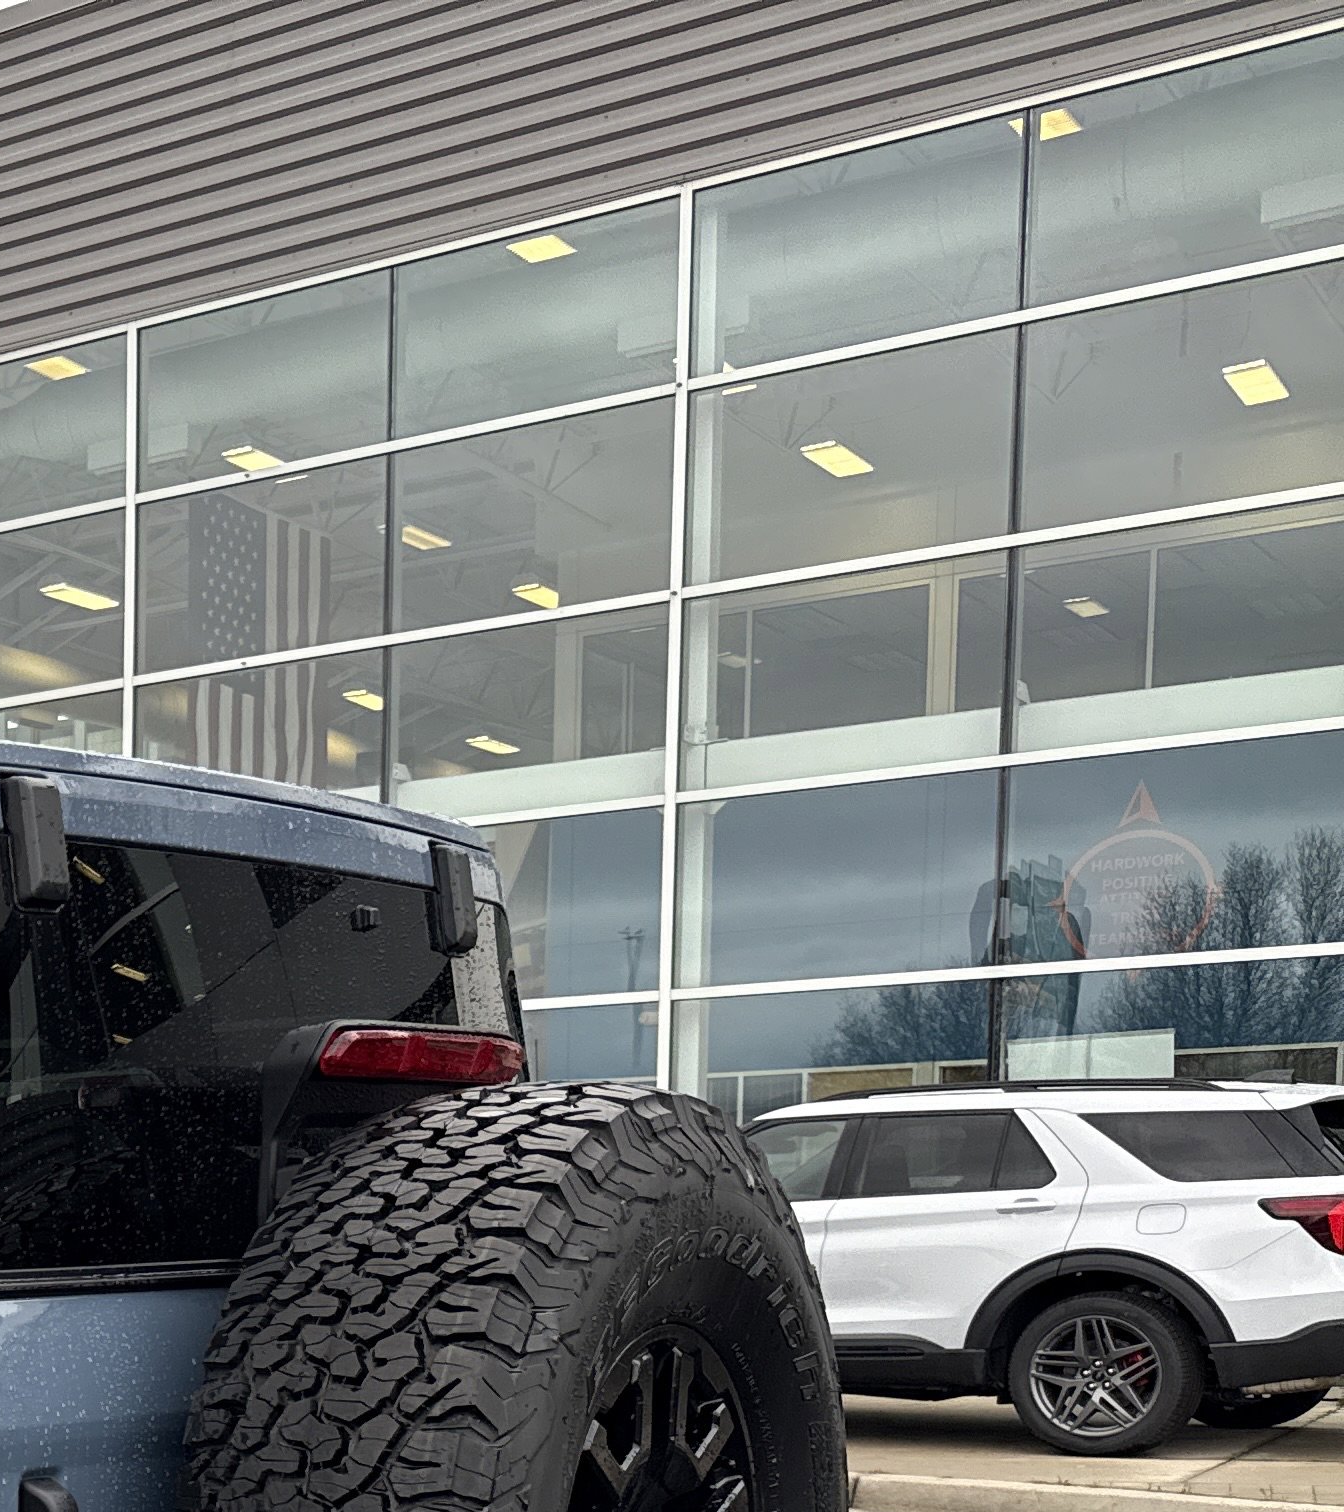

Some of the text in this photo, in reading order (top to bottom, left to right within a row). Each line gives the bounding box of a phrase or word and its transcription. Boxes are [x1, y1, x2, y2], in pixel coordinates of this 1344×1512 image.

[1090, 852, 1185, 873] HARDWORK
[1102, 873, 1176, 891] POSITIVE
[1099, 888, 1172, 904] ATTIT
[1090, 926, 1180, 947] TEAM
